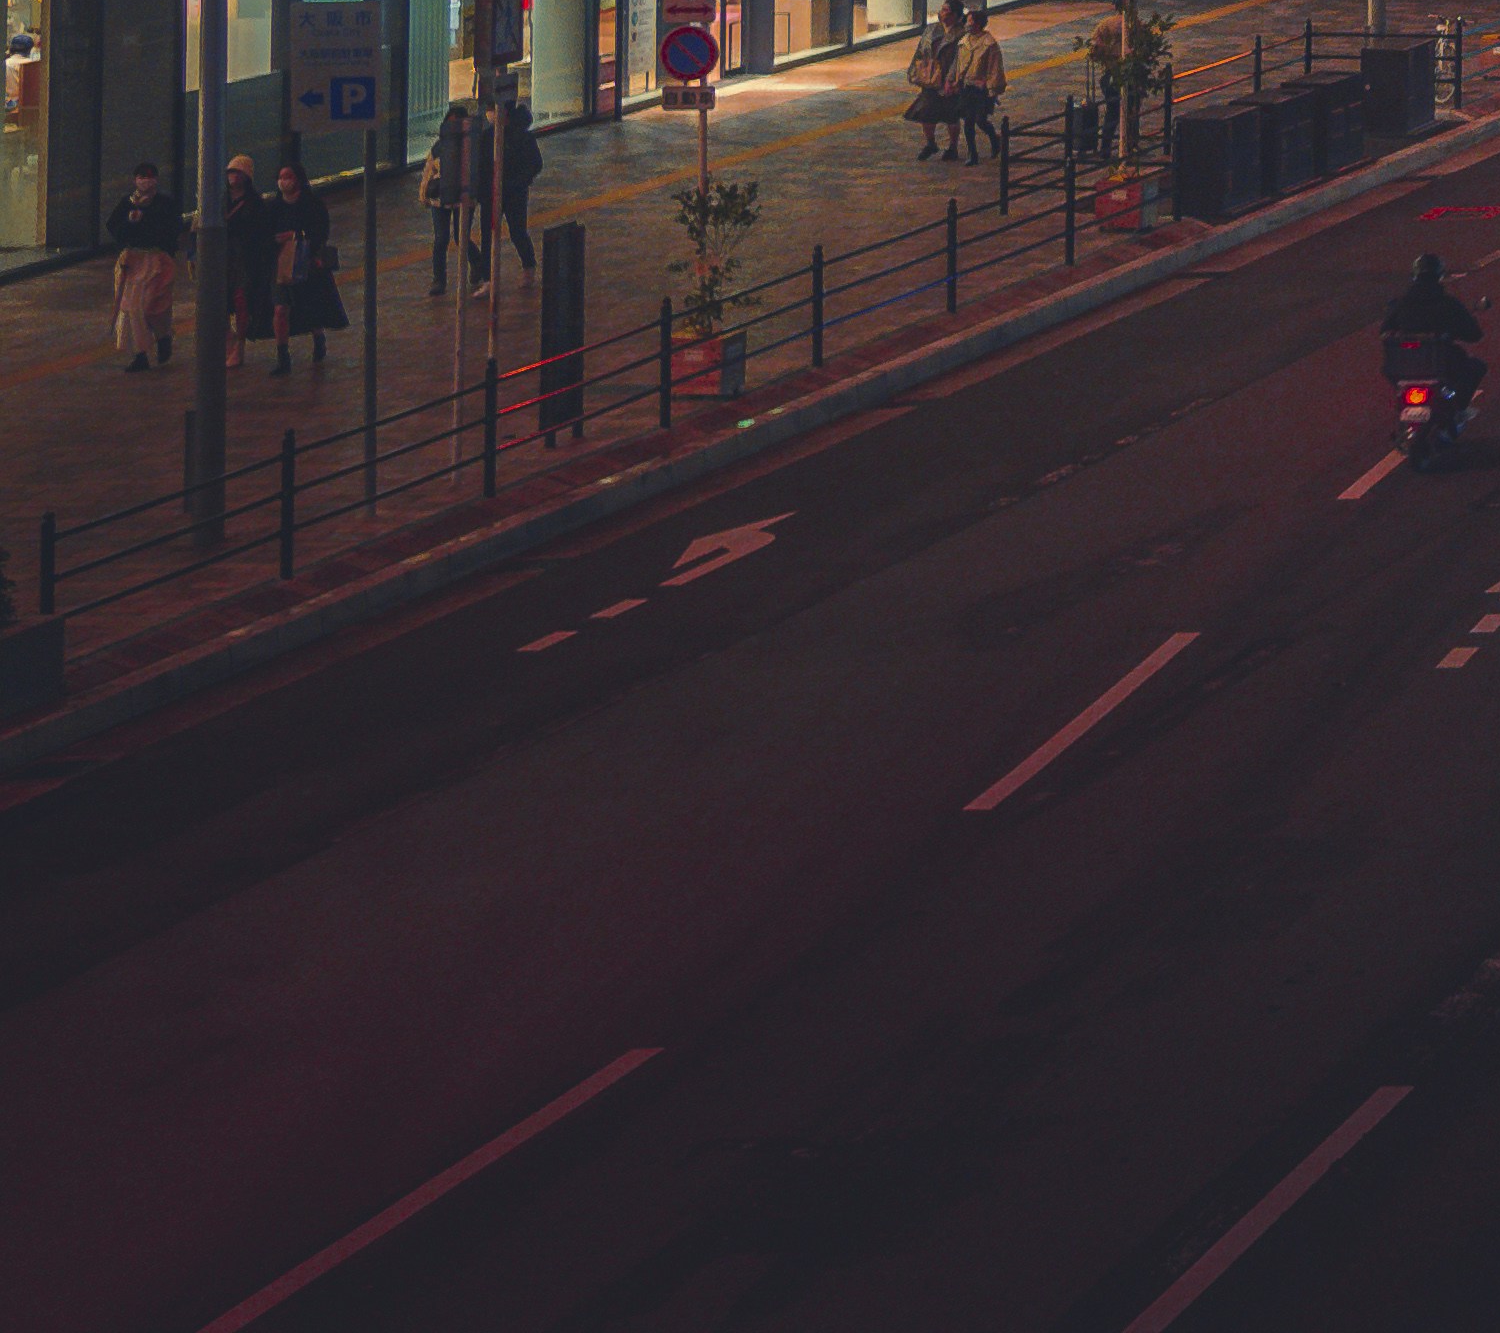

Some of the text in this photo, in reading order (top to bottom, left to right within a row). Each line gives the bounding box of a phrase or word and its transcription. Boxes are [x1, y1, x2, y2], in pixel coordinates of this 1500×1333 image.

[298, 10, 372, 27] 大阪市
[342, 84, 366, 115] P
